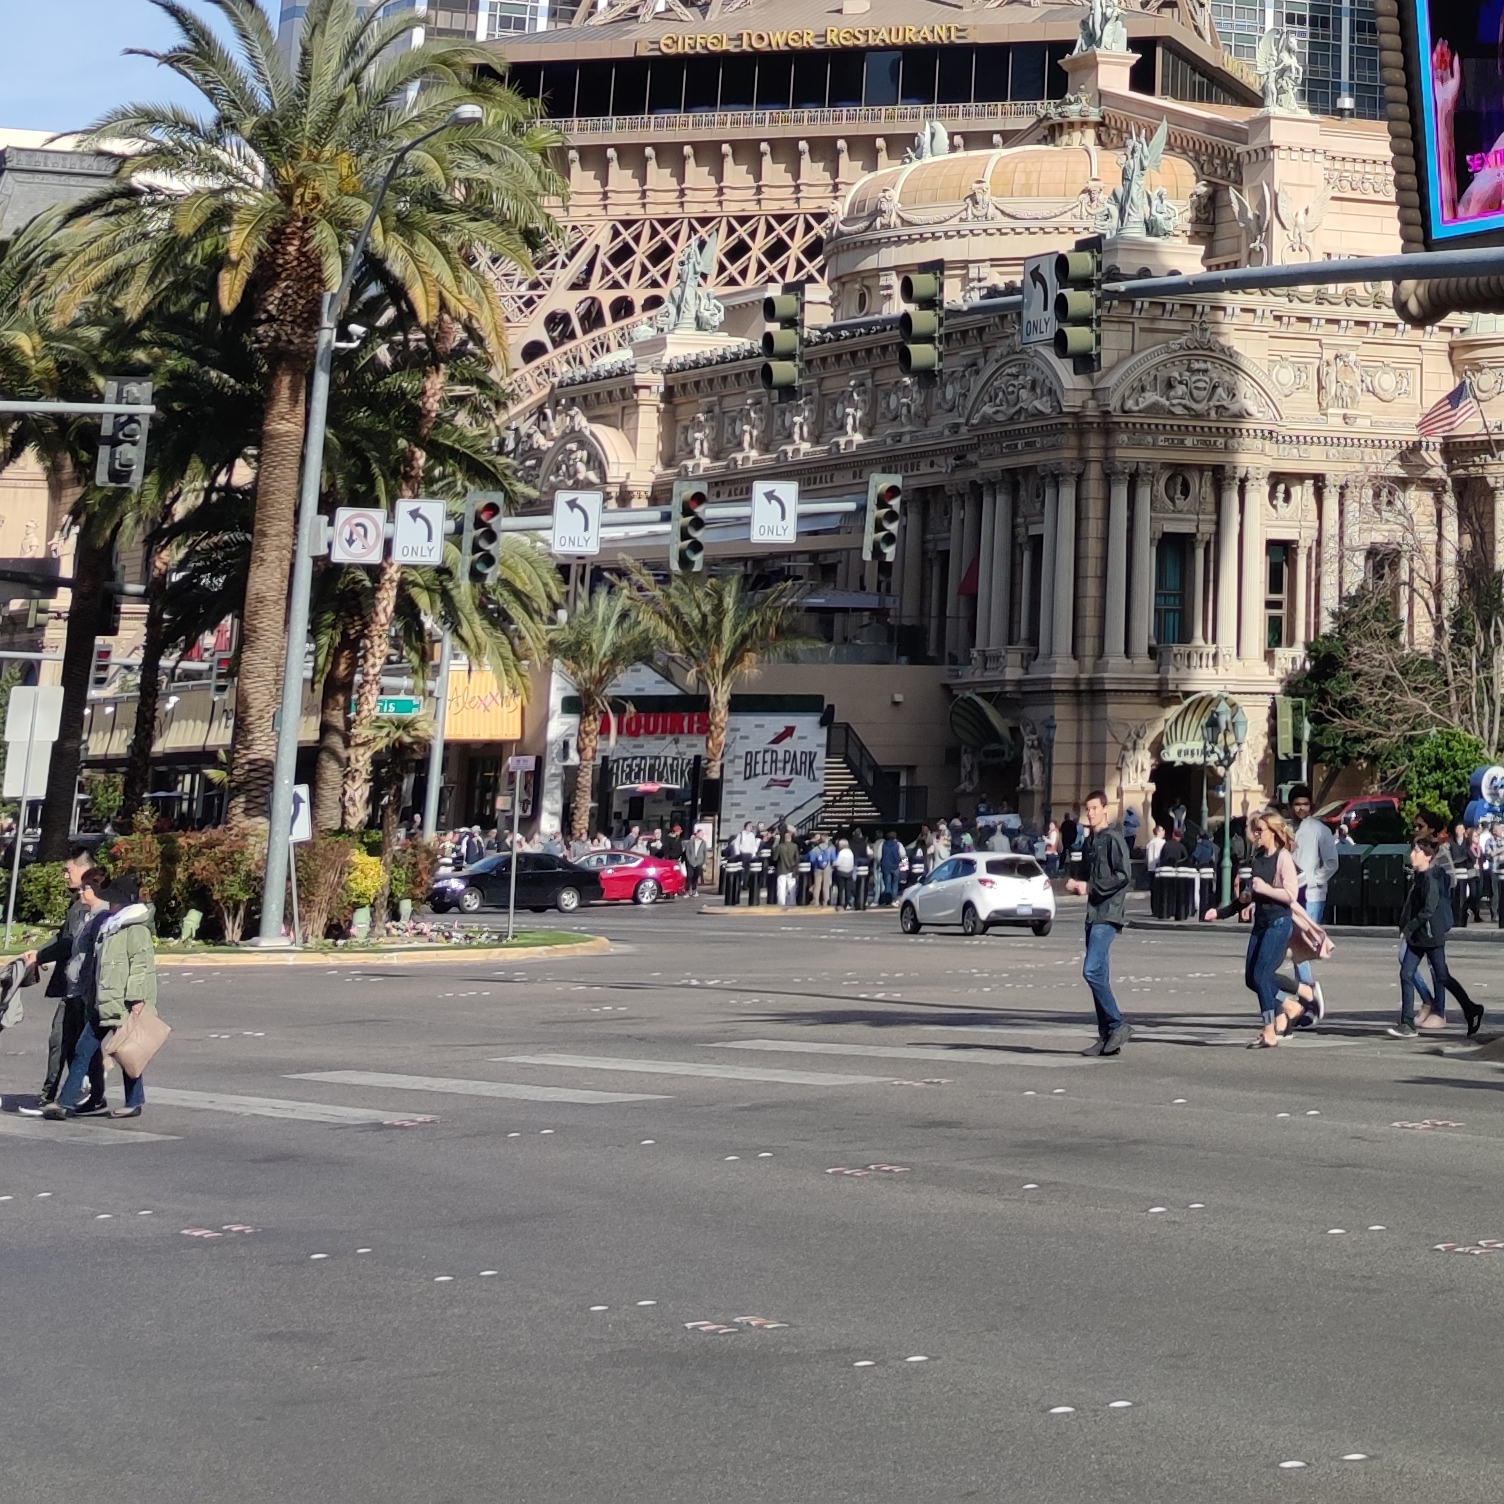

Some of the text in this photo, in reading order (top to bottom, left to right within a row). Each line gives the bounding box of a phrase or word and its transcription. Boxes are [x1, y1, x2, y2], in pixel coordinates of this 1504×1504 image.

[658, 23, 960, 54] EIFFEL TOWER RESTAURANT
[758, 523, 790, 538] ONLY
[401, 543, 435, 559] ONLY
[559, 534, 591, 549] ONLY
[598, 711, 710, 736] AIQUIRIS
[744, 749, 819, 781] BEER PARK
